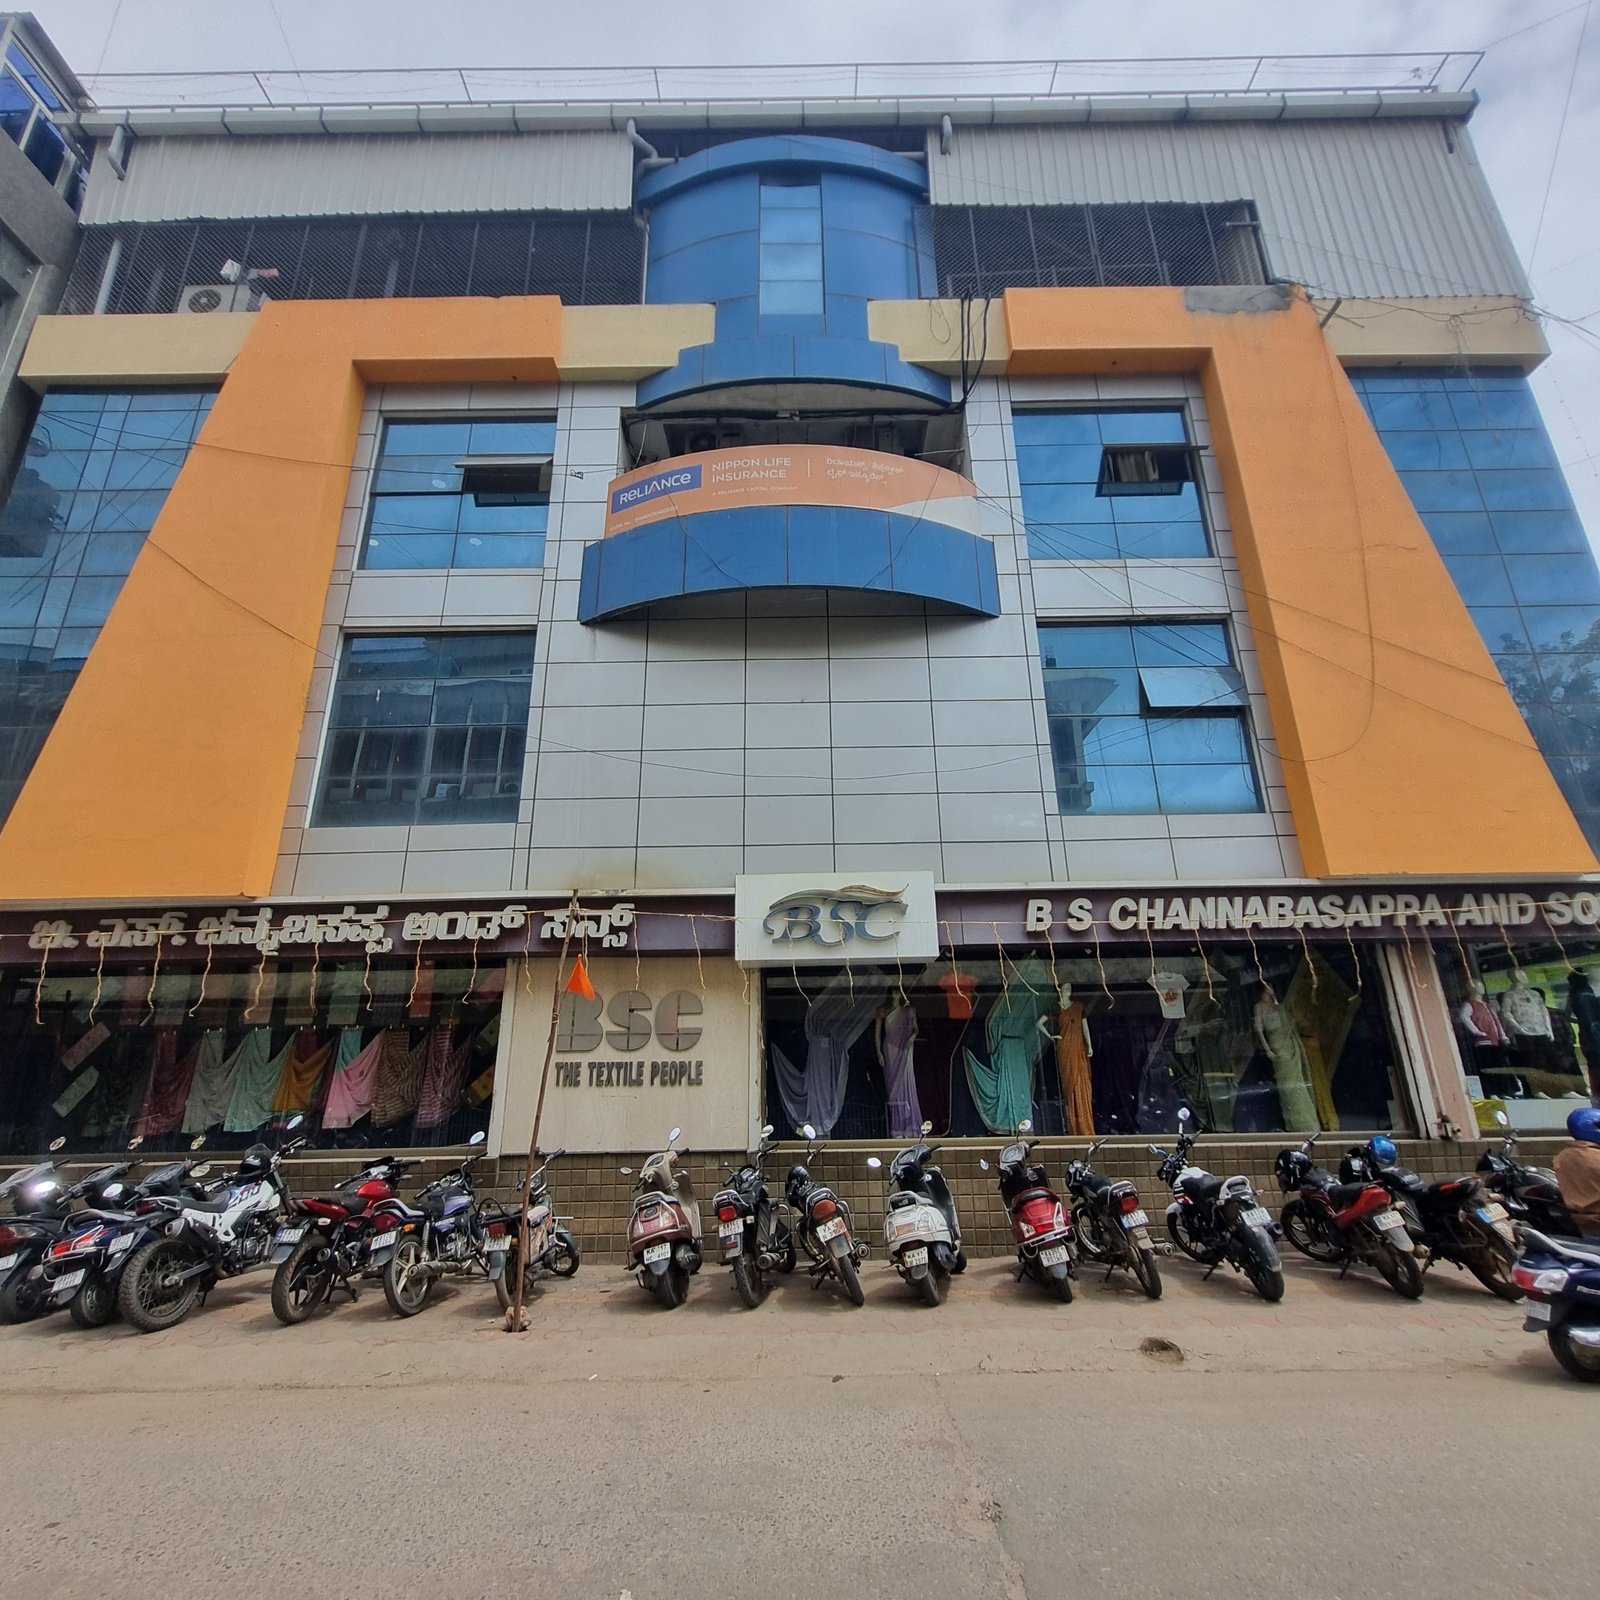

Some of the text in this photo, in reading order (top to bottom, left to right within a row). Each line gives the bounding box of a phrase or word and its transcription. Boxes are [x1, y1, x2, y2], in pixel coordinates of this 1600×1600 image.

[712, 457, 792, 472] NIPPON LIFE
[712, 469, 787, 484] INSURANCE
[763, 899, 910, 946] BSC
[1026, 891, 1600, 932] B S CHANNABASAPPA AND SO
[556, 990, 704, 1052] BSC
[555, 1060, 704, 1088] THE TEXTILE PEOPLE
